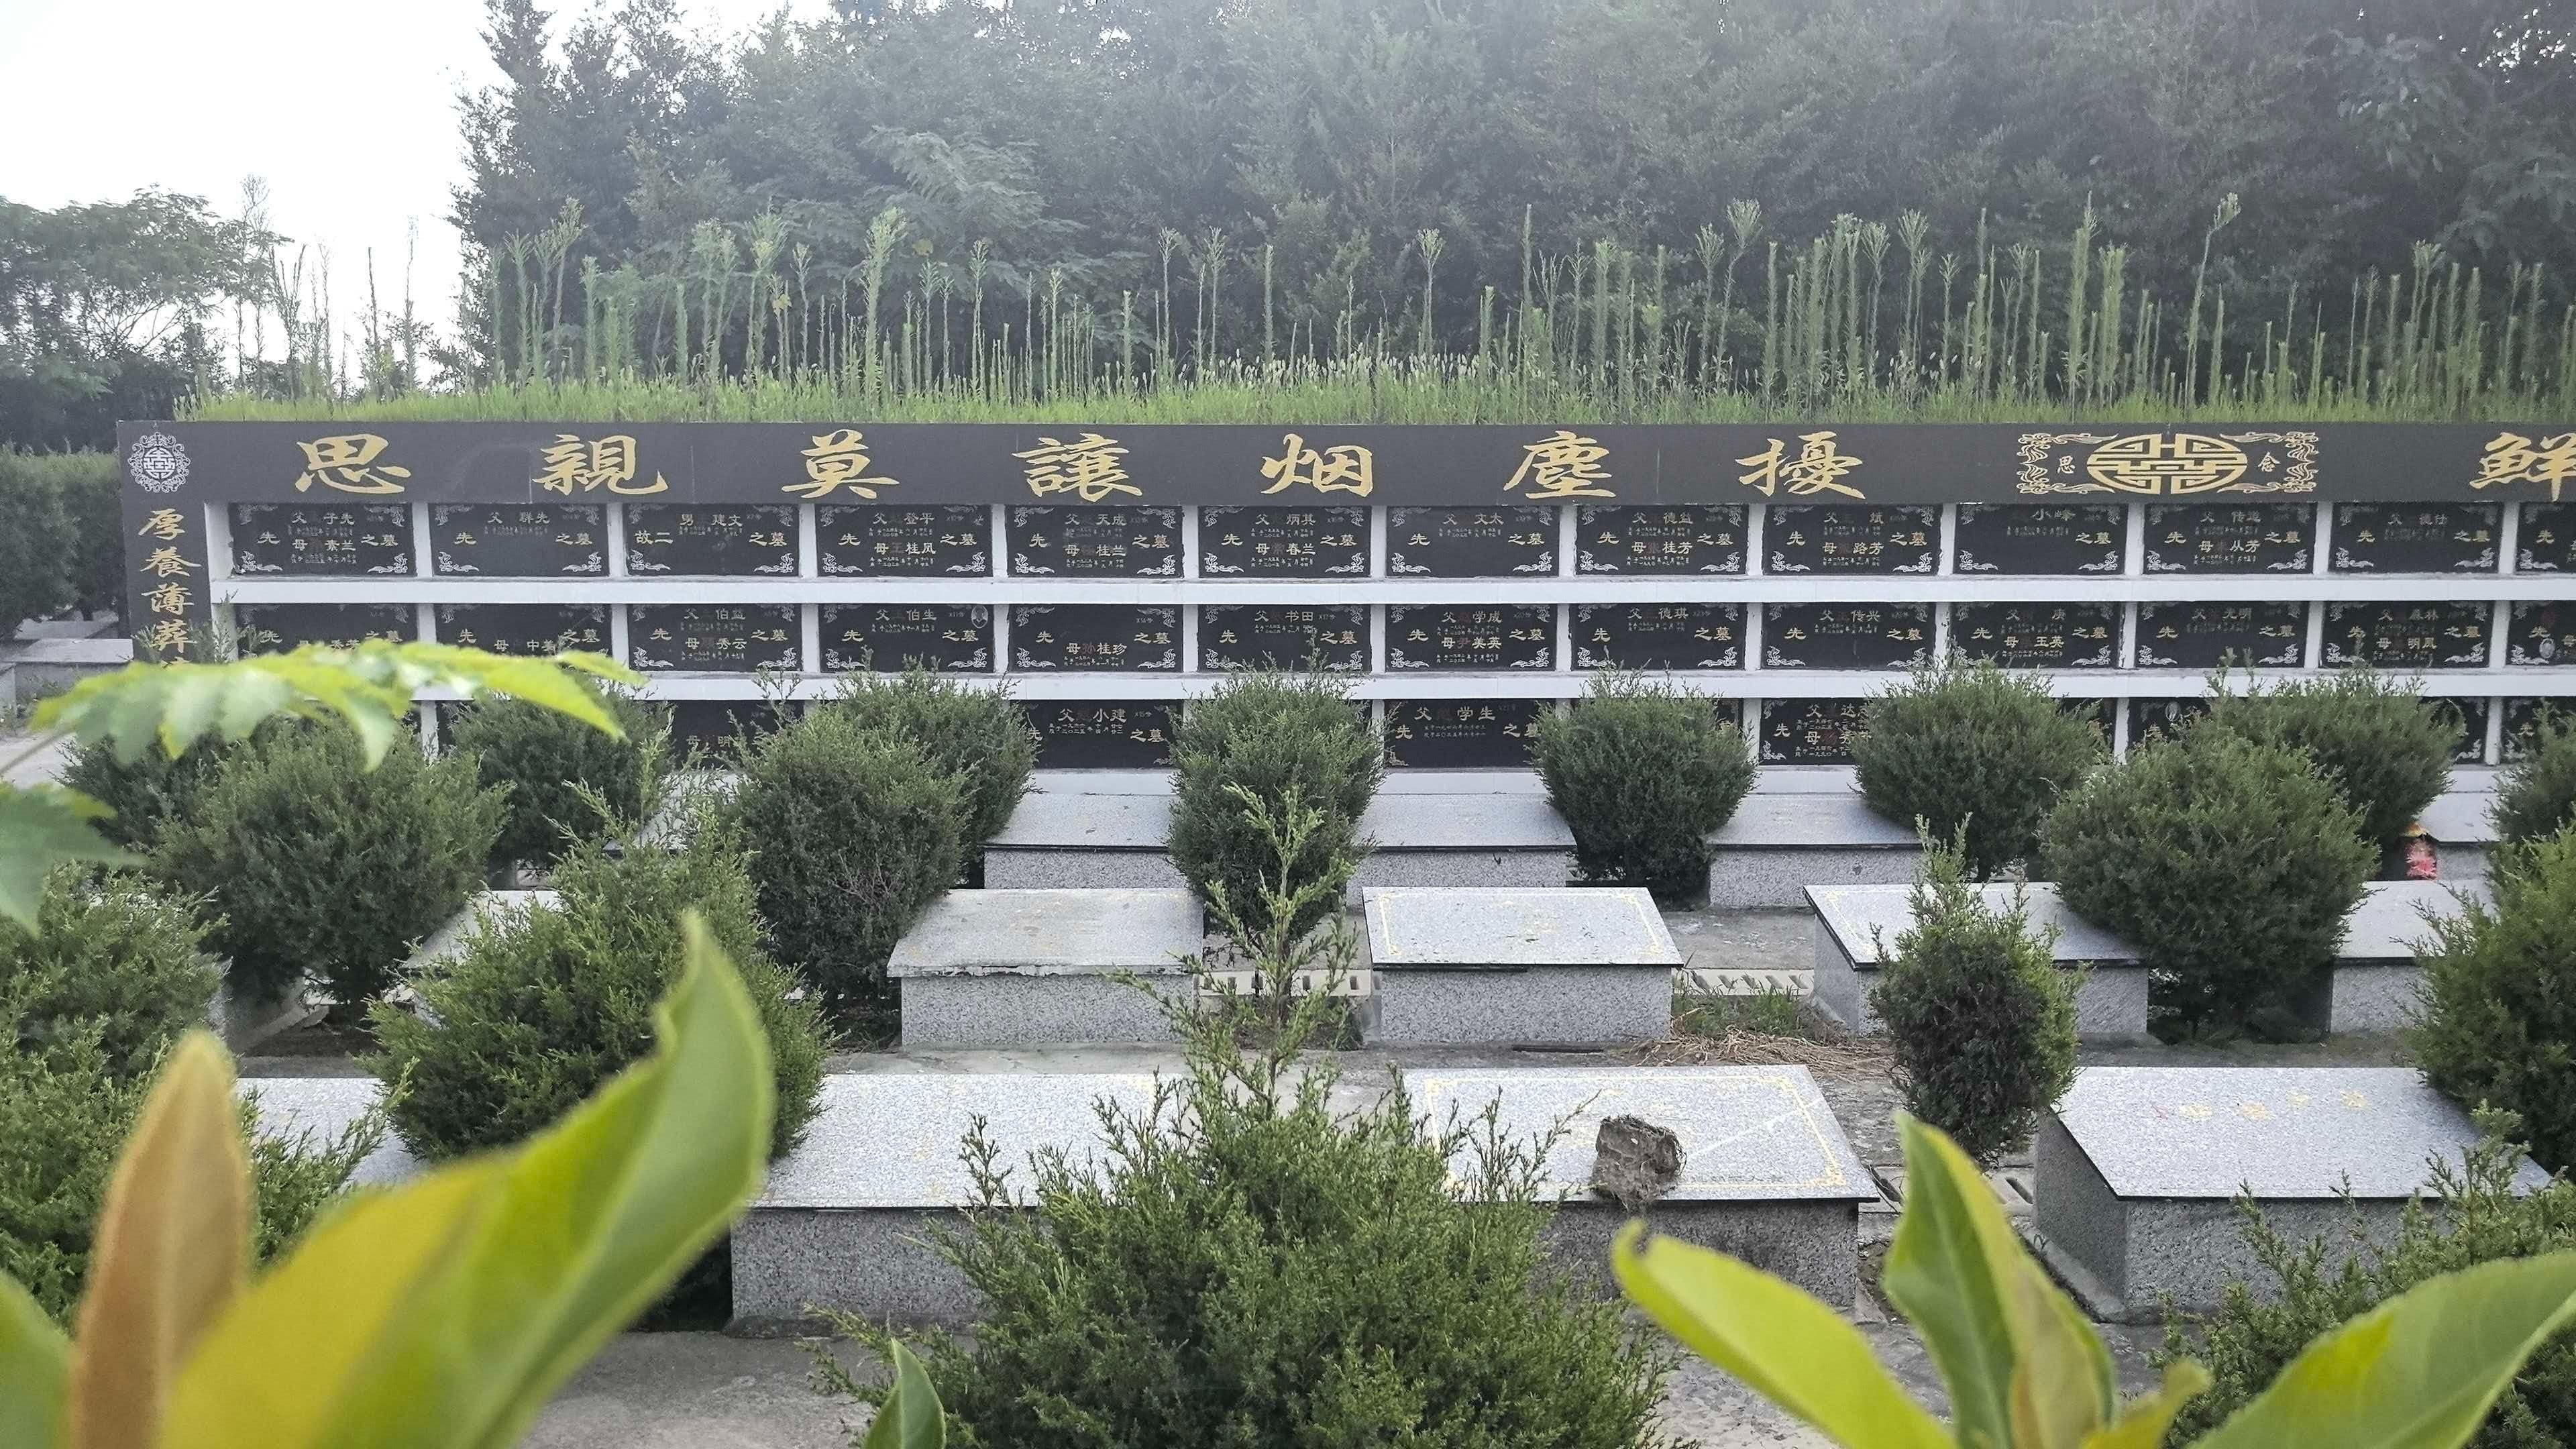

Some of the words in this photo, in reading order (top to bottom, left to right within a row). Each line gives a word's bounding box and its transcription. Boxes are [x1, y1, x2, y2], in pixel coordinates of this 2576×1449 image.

[258, 532, 280, 544] 先
[361, 535, 398, 546] 之墓
[454, 533, 476, 544] 先
[555, 533, 592, 545] 之墓
[749, 532, 787, 546] 之墓
[839, 533, 861, 545] 先
[941, 533, 977, 545] 之墓
[1030, 533, 1049, 547] 先
[1132, 535, 1169, 548] 之墓
[1222, 534, 1242, 545] 先
[1320, 535, 1356, 546] 之墓
[1408, 534, 1430, 545] 先
[1508, 533, 1544, 545] 之墓
[1597, 532, 1619, 544] 先
[1697, 533, 1733, 545] 之墓
[1787, 531, 1805, 545] 先
[1890, 532, 1927, 545] 之墓
[2076, 532, 2111, 544] 之墓
[2165, 532, 2186, 543] 先
[138, 508, 201, 665] 厚養薄葬
[458, 629, 477, 643] 先
[561, 629, 600, 643] 之墓
[649, 629, 672, 640] 先
[751, 629, 788, 641] 之墓
[842, 630, 863, 641] 先
[943, 630, 979, 642] 之墓
[1036, 631, 1054, 643] 先
[1134, 633, 1171, 644] 之墓
[1220, 630, 1237, 643] 先
[1320, 631, 1357, 644] 之墓
[1407, 629, 1428, 641] 先
[1509, 629, 1545, 641] 之墓
[1592, 628, 1610, 641] 先
[1695, 627, 1731, 641] 之墓
[1784, 628, 1806, 639] 先
[1887, 628, 1923, 640] 之墓
[1971, 628, 1992, 639] 先
[2072, 627, 2108, 638] 之墓
[2156, 627, 2178, 638] 先
[1130, 729, 1165, 743] 之墓
[1395, 724, 1413, 739] 先
[1774, 723, 1790, 737] 先
